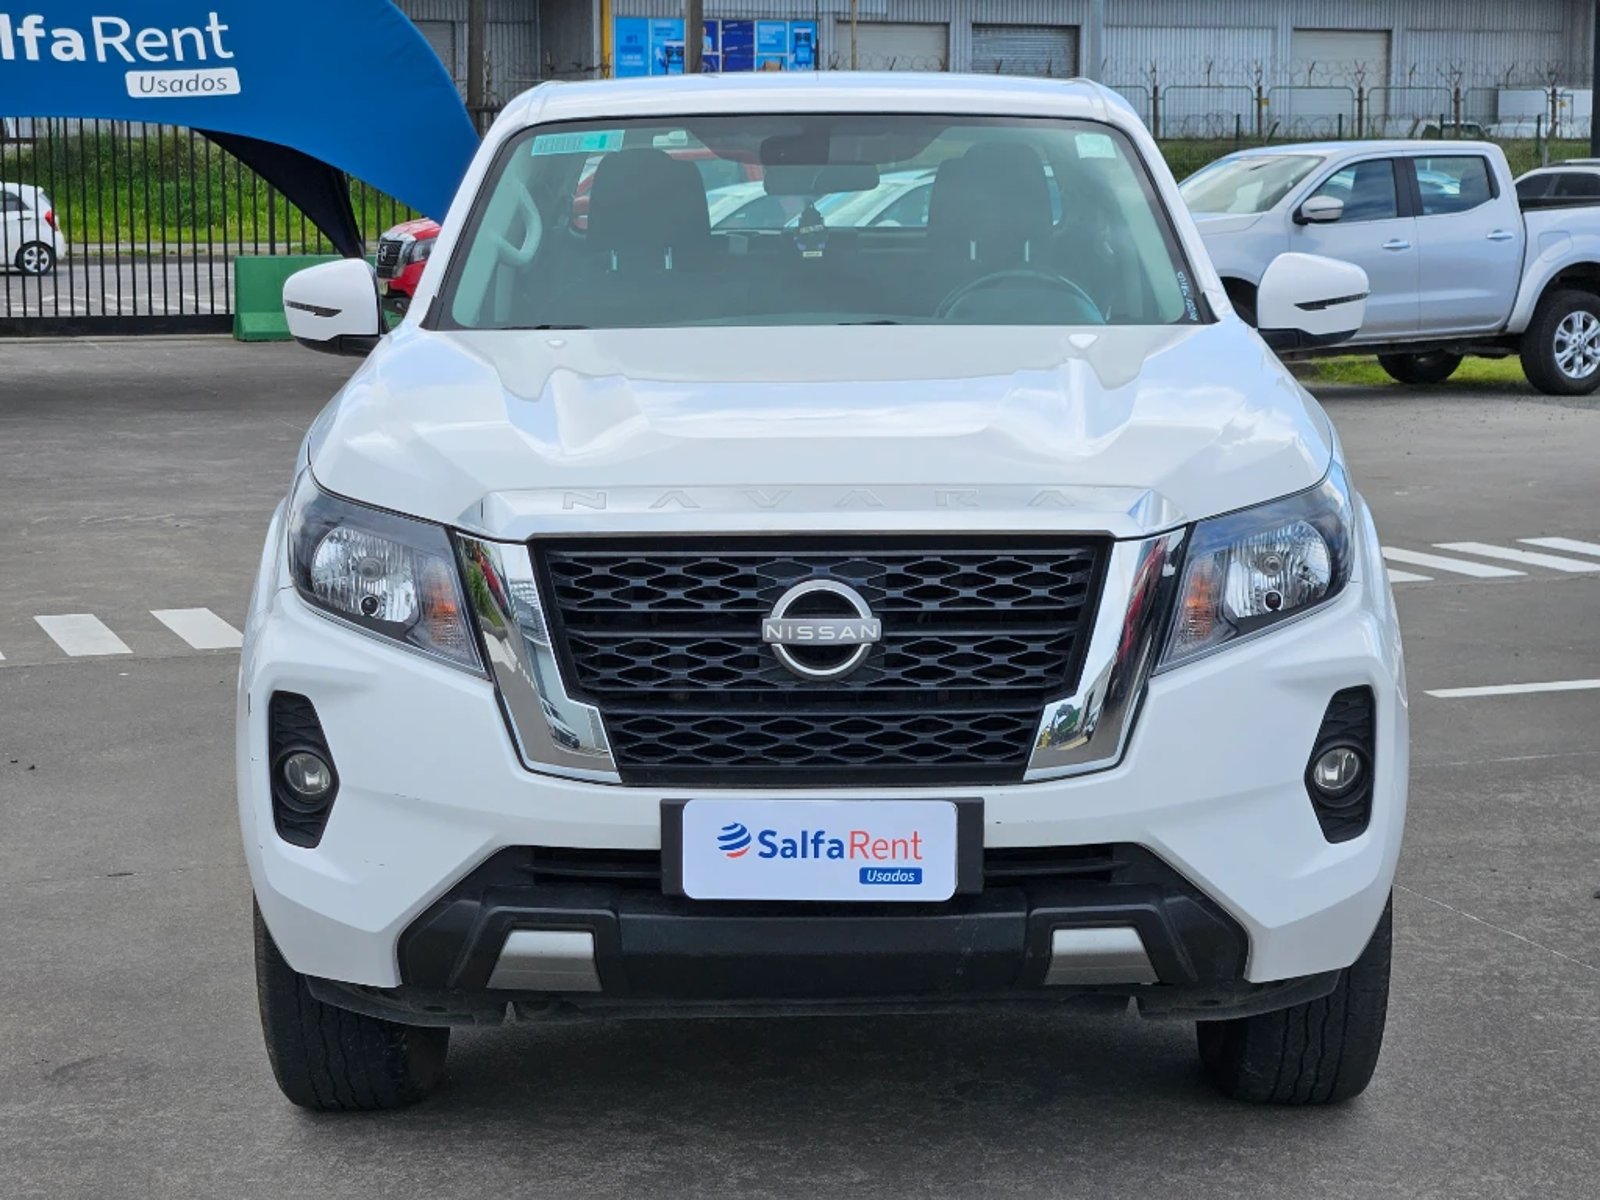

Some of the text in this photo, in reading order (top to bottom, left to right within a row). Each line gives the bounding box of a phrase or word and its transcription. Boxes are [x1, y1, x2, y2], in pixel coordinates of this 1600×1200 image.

[139, 73, 228, 94] Usados
[561, 488, 1076, 511] NAVARA
[766, 624, 877, 640] NISSAN
[757, 829, 923, 861] SalfaRent
[866, 869, 915, 883] Usados
